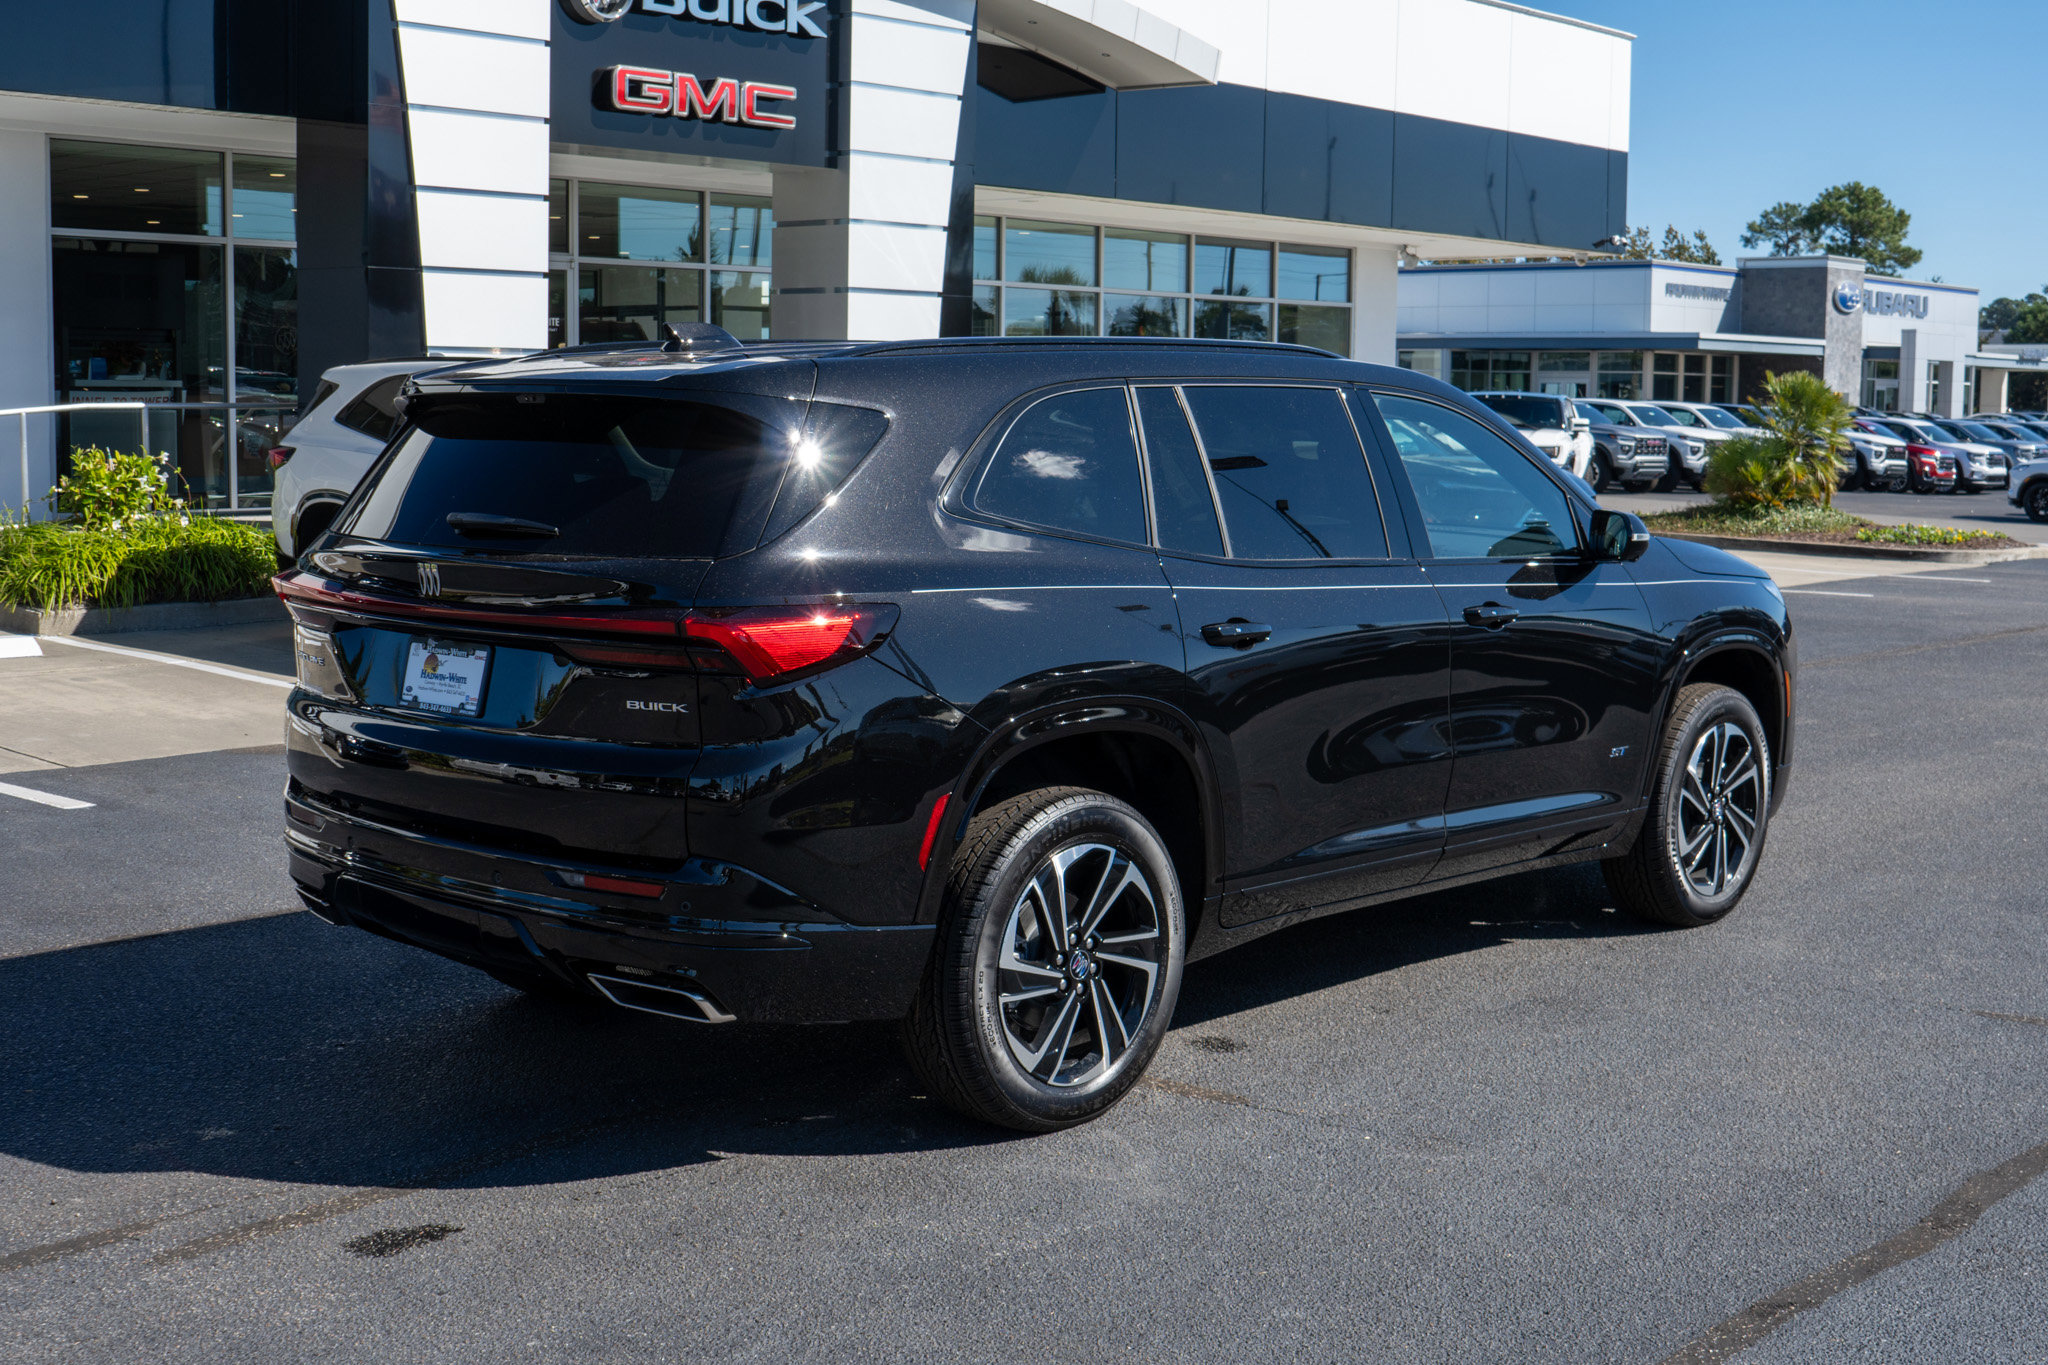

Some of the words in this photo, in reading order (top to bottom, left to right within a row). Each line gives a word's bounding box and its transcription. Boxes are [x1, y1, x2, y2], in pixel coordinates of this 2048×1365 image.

[612, 64, 798, 130] GMC
[626, 700, 689, 713] BUICK
[1609, 745, 1629, 758] ST
